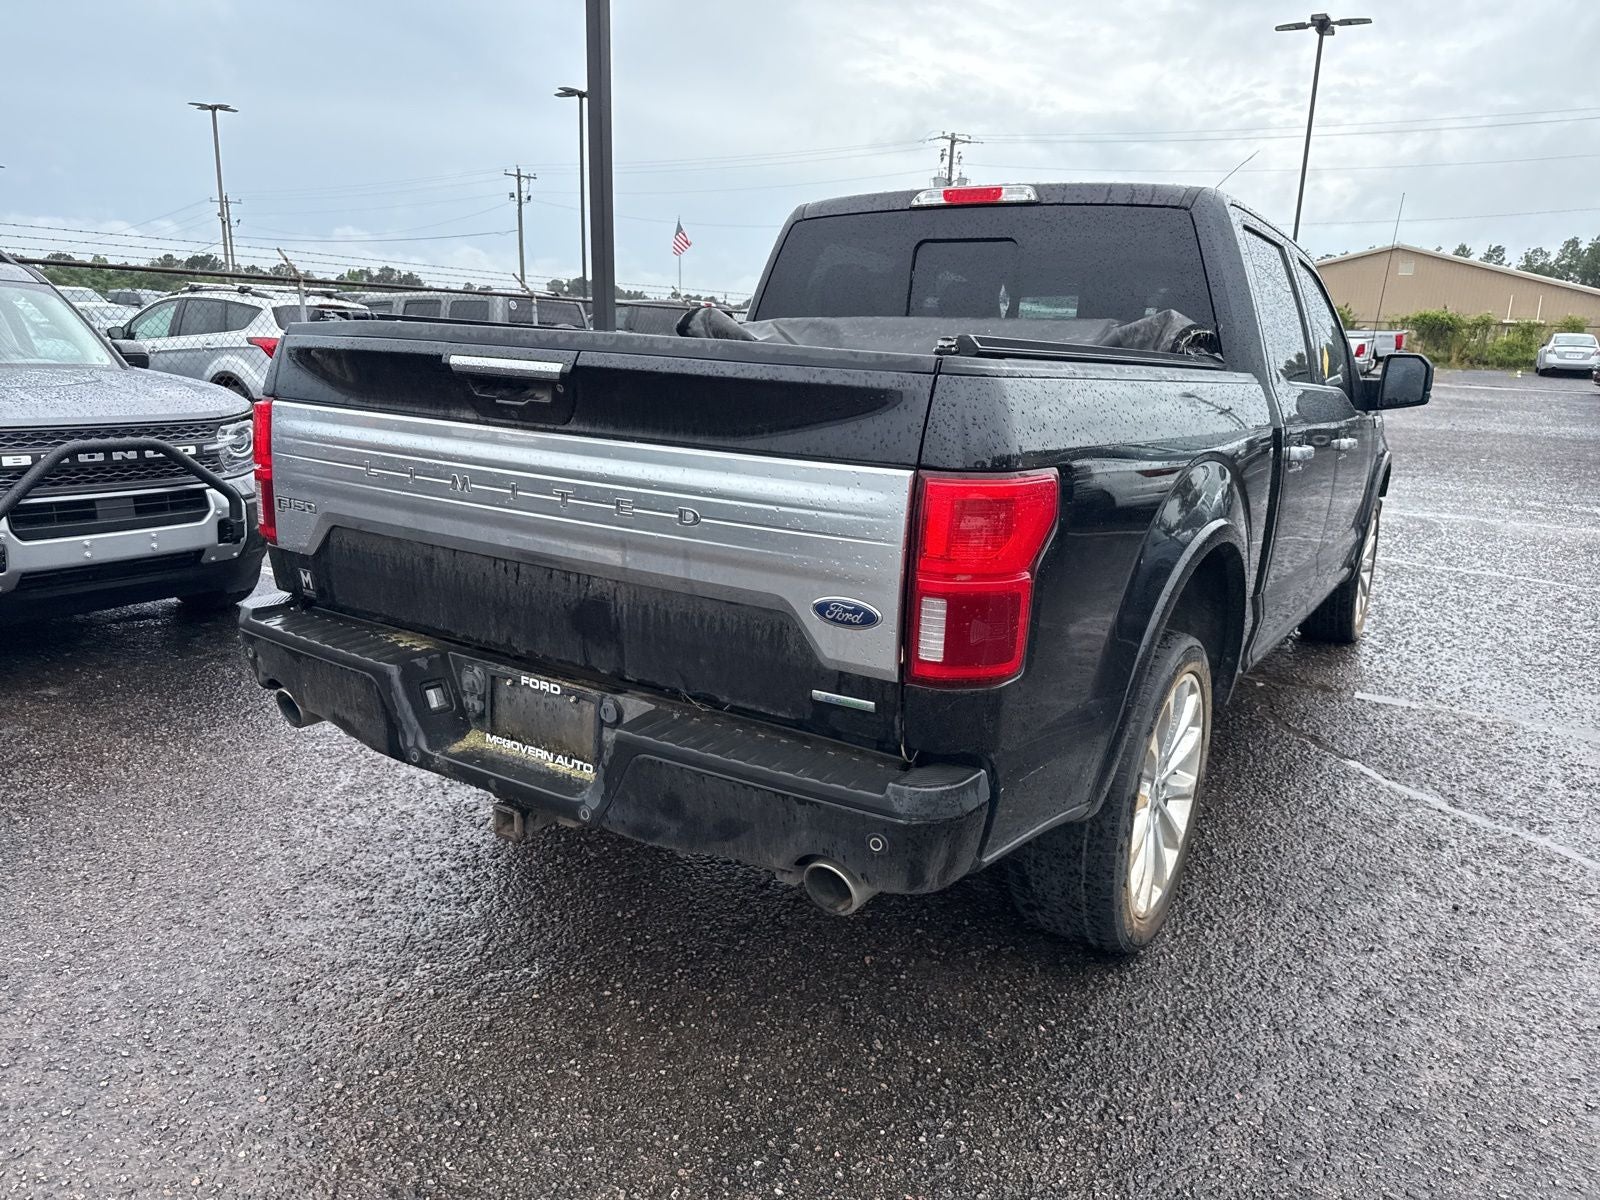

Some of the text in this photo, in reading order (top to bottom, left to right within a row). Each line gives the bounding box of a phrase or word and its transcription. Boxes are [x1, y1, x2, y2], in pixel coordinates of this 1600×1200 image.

[2, 445, 196, 466] BONO
[364, 460, 701, 527] LIMITED
[299, 569, 314, 591] M
[825, 602, 864, 624] Ford
[520, 675, 561, 695] FORD
[554, 754, 594, 774] AUTO
